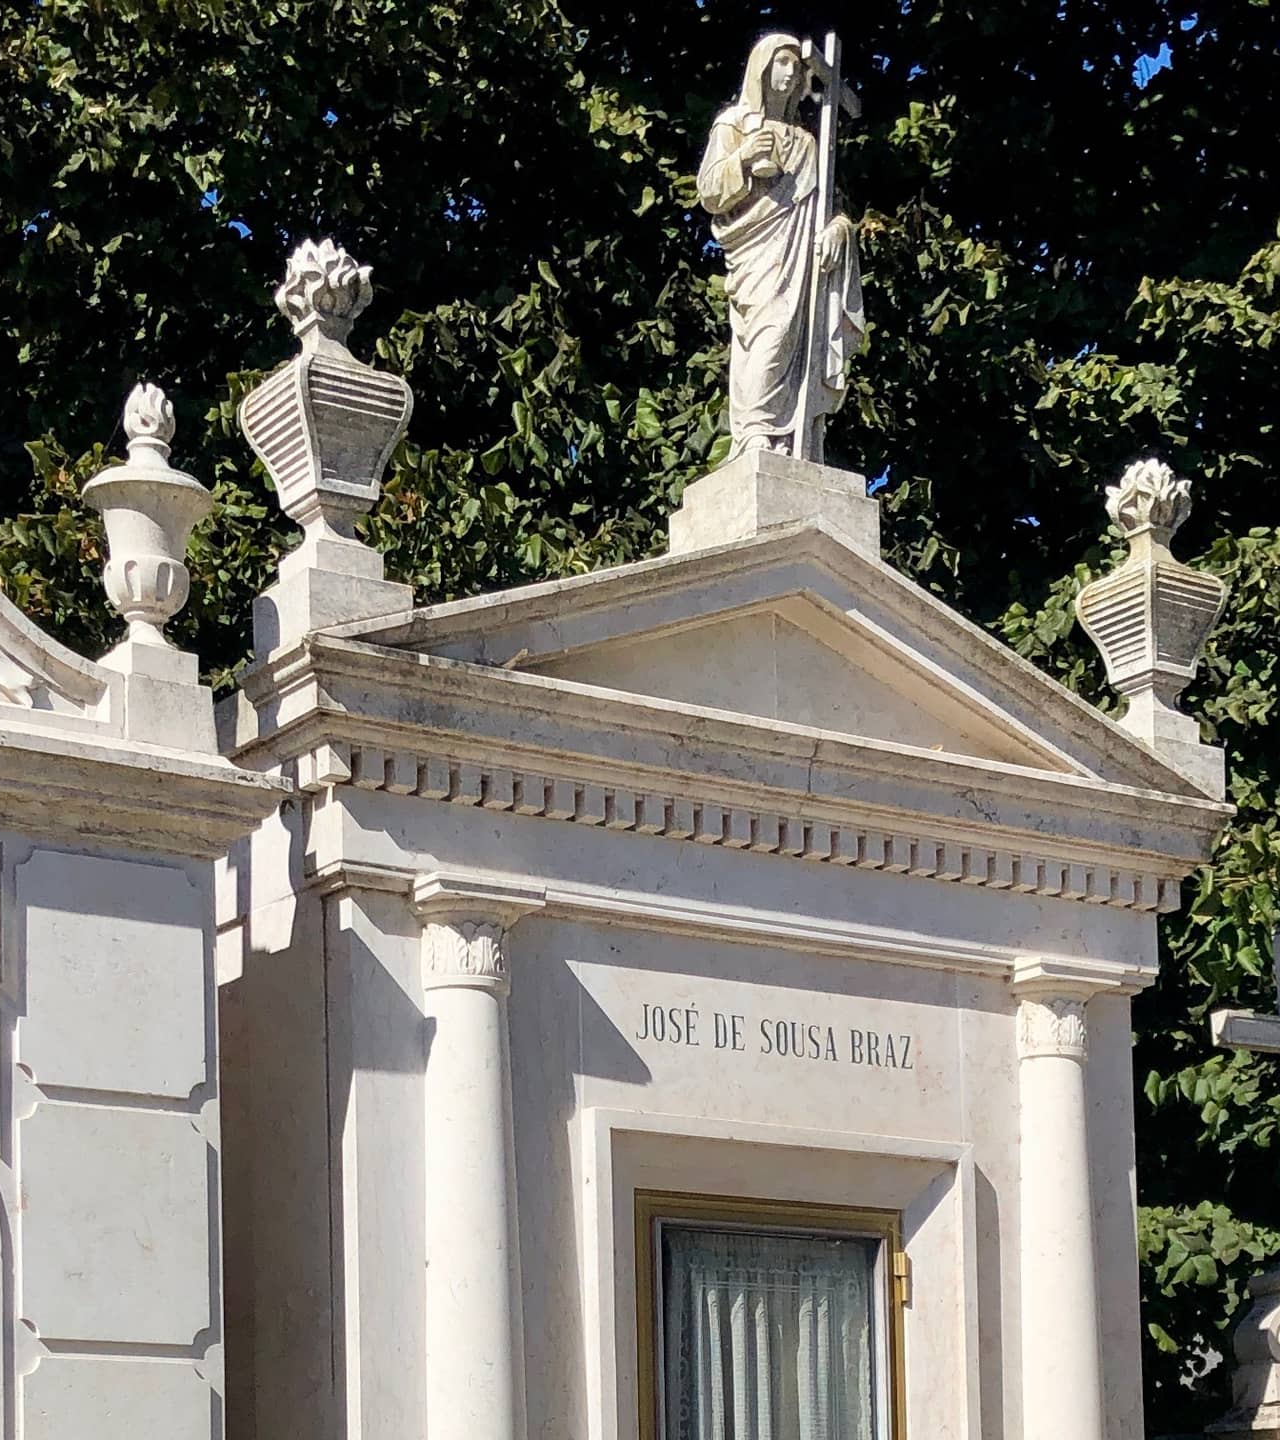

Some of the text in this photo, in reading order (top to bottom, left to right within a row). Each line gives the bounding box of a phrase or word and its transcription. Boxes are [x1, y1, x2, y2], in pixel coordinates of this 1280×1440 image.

[636, 1002, 914, 1070] JOSÉ DE SOUSA BRAZ
